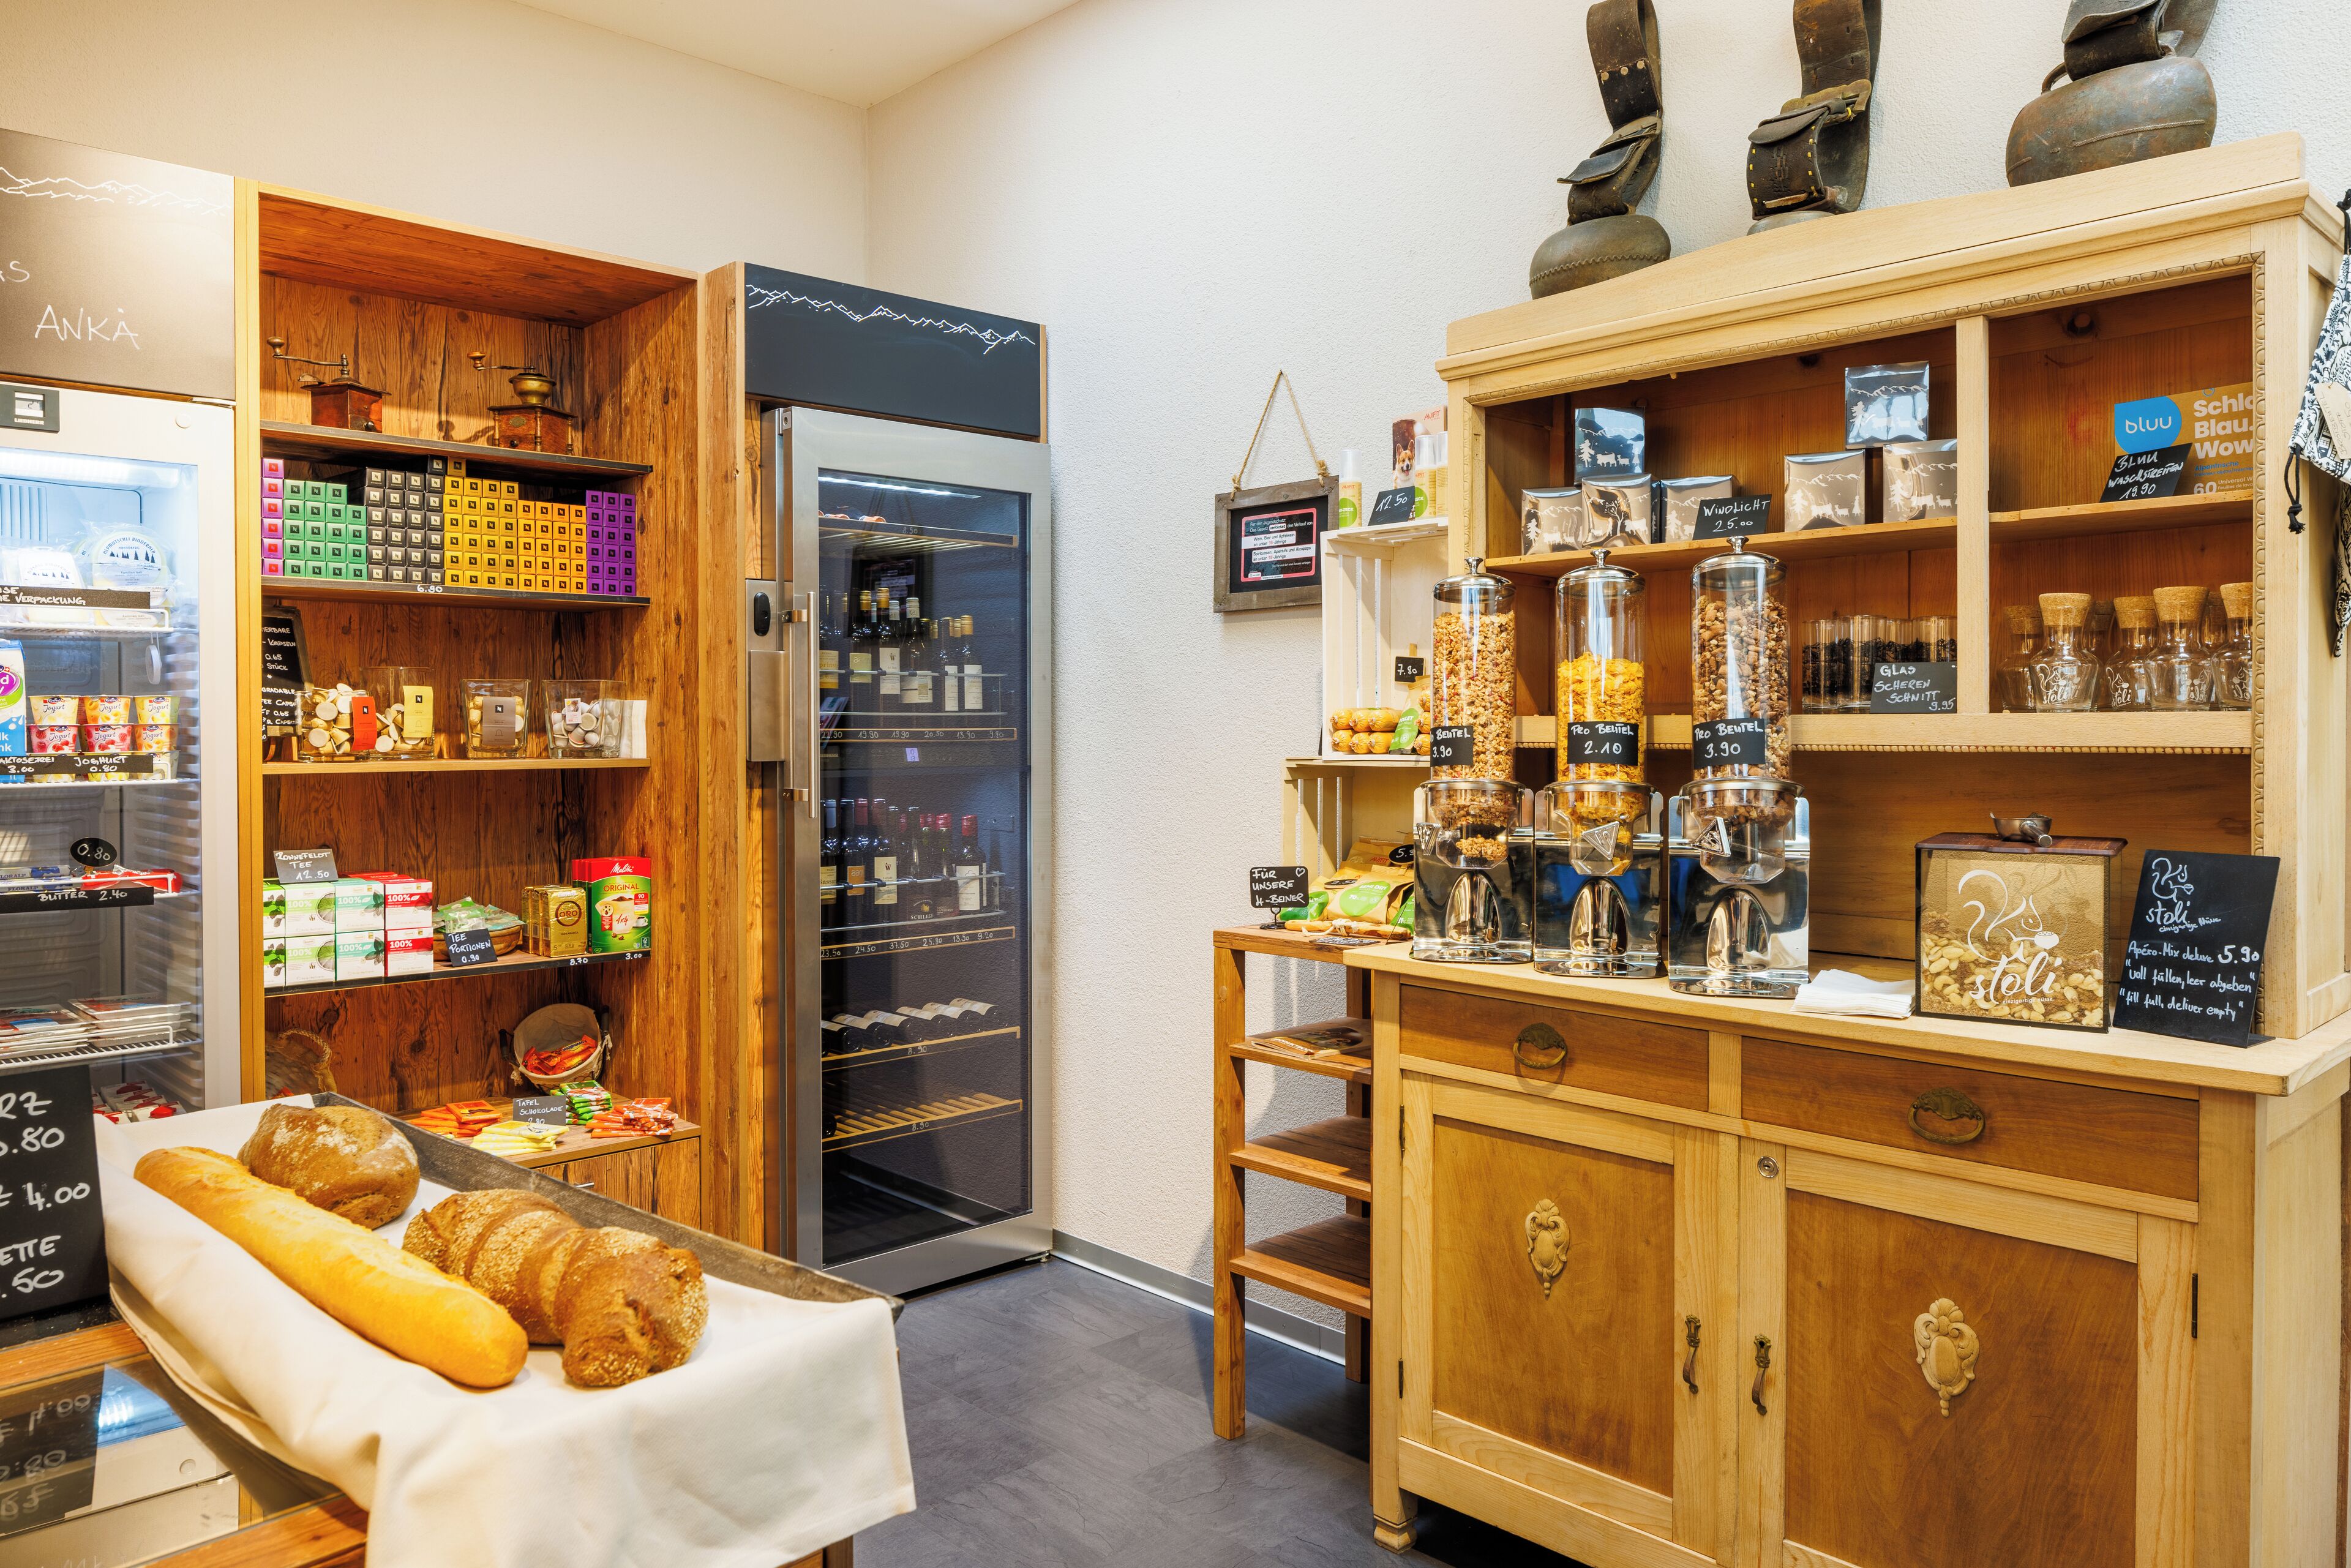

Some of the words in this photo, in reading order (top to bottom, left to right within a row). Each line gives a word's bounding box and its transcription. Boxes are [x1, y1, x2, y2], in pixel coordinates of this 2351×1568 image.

[2125, 416, 2172, 434] bluu
[2115, 451, 2158, 473] BLUU
[2119, 484, 2156, 500] 19.90
[2194, 481, 2217, 495] 60
[1376, 492, 1408, 512] 12.50
[1703, 499, 1771, 517] WINDLICHT
[1712, 516, 1754, 532] 25.00
[417, 584, 443, 593] 6.90
[15, 592, 86, 606] VERPACKUNG
[1397, 664, 1417, 675] 7.80
[1880, 664, 1916, 677] GLAS
[1873, 679, 1931, 692] SCHEREN
[1886, 690, 1941, 704] SCHNITT
[43, 704, 65, 713] Jogurt
[100, 703, 121, 712] Jogurt
[148, 703, 169, 712] Jogurt
[1929, 697, 1957, 711] 9.95
[142, 731, 163, 741] Jogurt
[1436, 727, 1471, 740] BEUTEL
[1571, 726, 1591, 737] PRO
[1596, 722, 1635, 735] BEUTEL
[1695, 728, 1712, 740] PRO
[1715, 719, 1763, 735] BEUTEL
[48, 733, 70, 741] Jogurt
[94, 732, 116, 741] Jogurt
[1432, 745, 1452, 758] 3.90
[1584, 740, 1623, 756] 2.10
[1704, 741, 1741, 758] 3.90
[73, 756, 129, 767] JOGHURT
[89, 765, 118, 773] 0.80
[77, 844, 111, 861] 0.80
[289, 861, 313, 869] TEE
[610, 862, 634, 874] Melitta
[296, 870, 329, 881] 12.50
[1251, 868, 1277, 879] FÜR
[604, 883, 640, 892] ORIGINAL
[1252, 880, 1295, 891] UNSERE
[37, 890, 88, 902] BUTTER
[99, 890, 127, 901] 2.40
[2146, 901, 2191, 925] stoli
[448, 932, 467, 942] TEE
[390, 940, 413, 948] 100%
[449, 940, 492, 953] PORTIONEN
[855, 945, 876, 955] 24.50
[287, 948, 312, 957] 100%
[461, 954, 479, 963] 0.90
[2128, 940, 2180, 959] Apéro-Mix
[2182, 946, 2214, 964] deluxe
[2218, 945, 2260, 964] 5.90
[1969, 951, 2063, 1005] stoli
[2186, 971, 2206, 985] leer
[2167, 996, 2203, 1015] deliver
[516, 1098, 539, 1107] TAFEL
[519, 1106, 564, 1116] SCHOKOLADE
